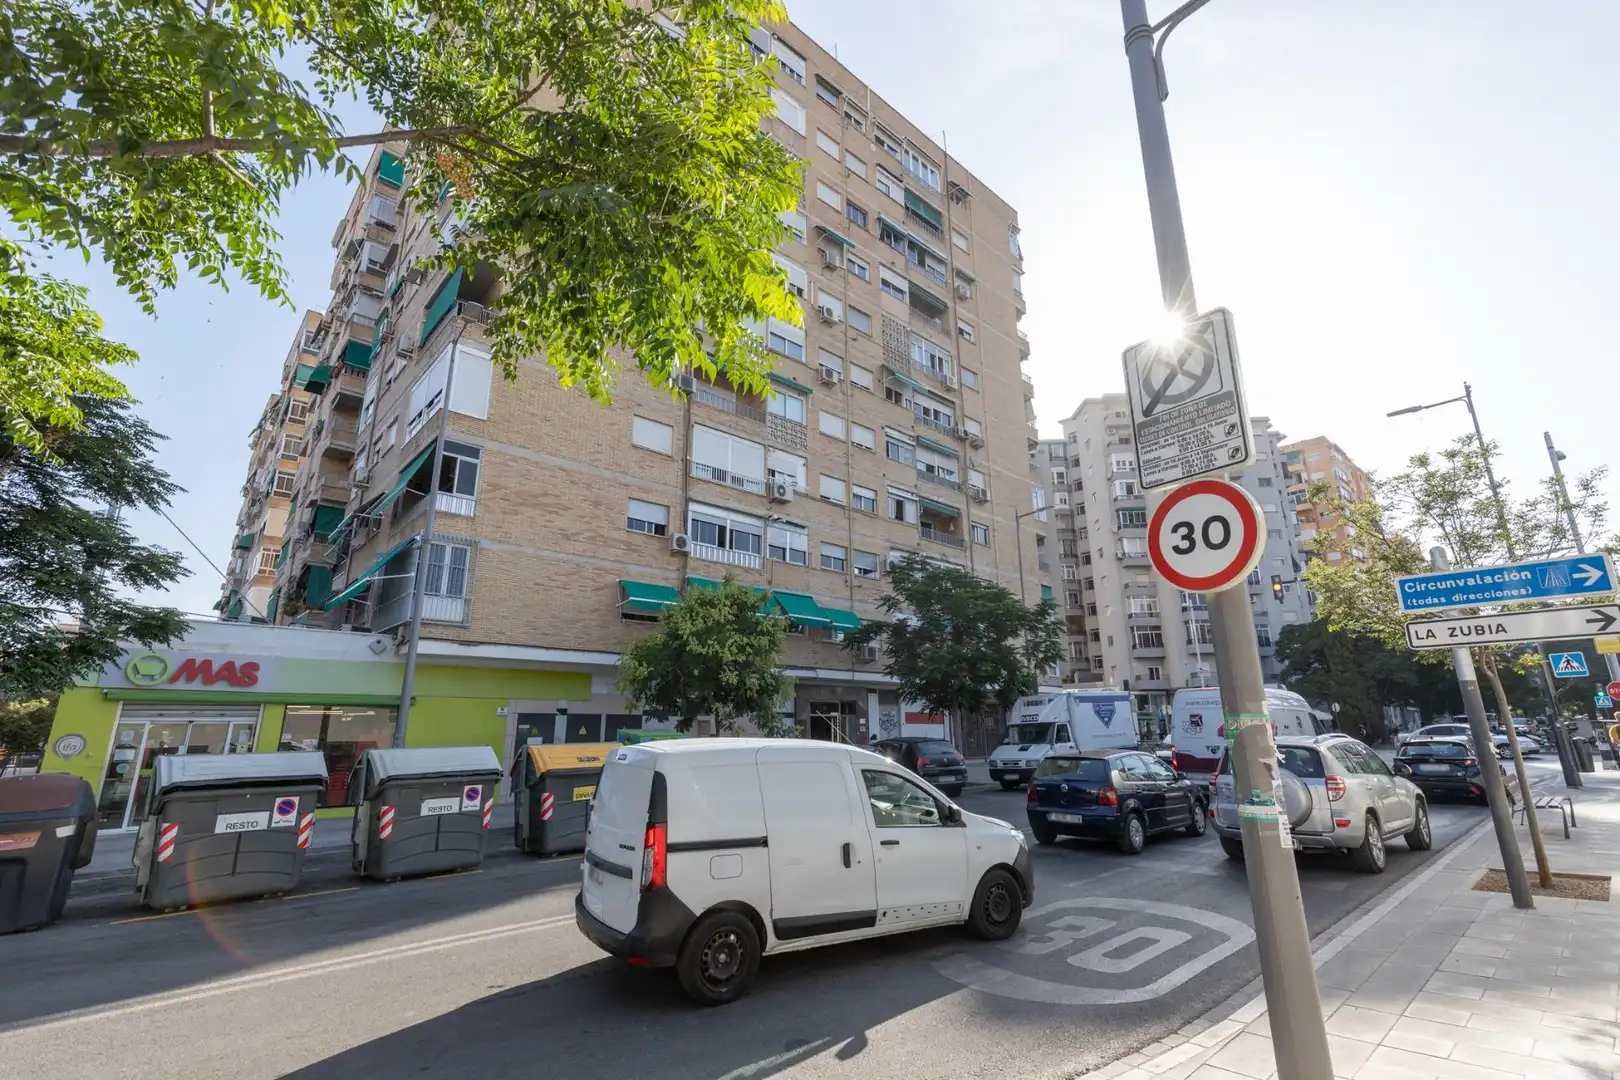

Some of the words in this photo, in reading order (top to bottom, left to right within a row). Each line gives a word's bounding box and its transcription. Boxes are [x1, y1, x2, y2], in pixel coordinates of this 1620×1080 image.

[1180, 404, 1197, 414] ZONA
[1195, 407, 1235, 425] OBLIGATORIO
[1141, 411, 1197, 435] ESTACIONAMIENTO
[1170, 514, 1231, 555] 30
[1404, 570, 1532, 593] Circunvalación
[1407, 597, 1447, 606] (todas
[1452, 586, 1532, 603] direcciones)
[1415, 628, 1437, 640] LA
[1447, 623, 1508, 638] ZUBIA
[168, 658, 260, 687] MAS
[62, 742, 77, 752] ifa
[428, 805, 452, 813] RESTO
[225, 820, 258, 831] RESTO
[1000, 916, 1192, 973] 30
